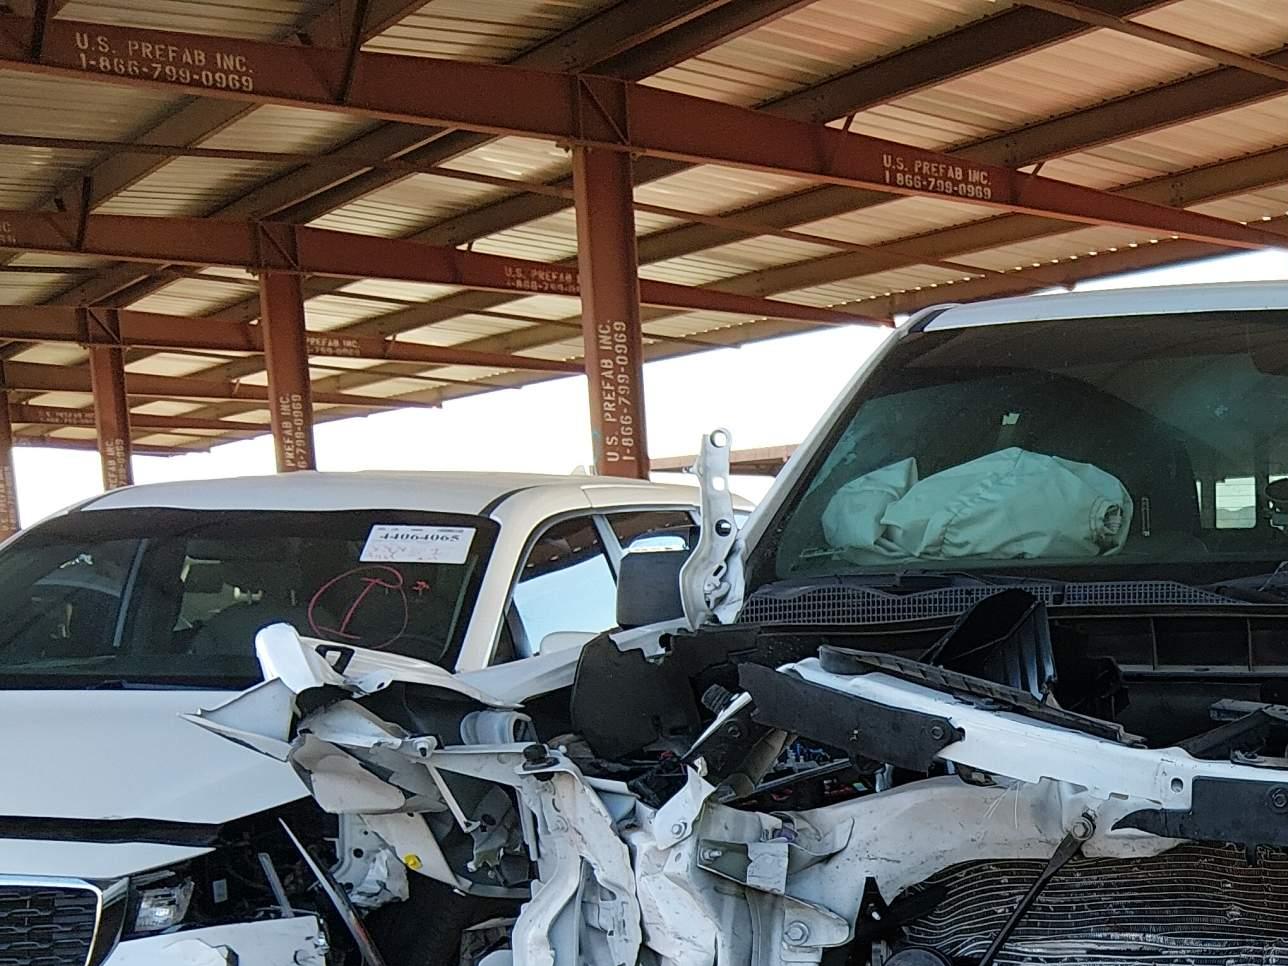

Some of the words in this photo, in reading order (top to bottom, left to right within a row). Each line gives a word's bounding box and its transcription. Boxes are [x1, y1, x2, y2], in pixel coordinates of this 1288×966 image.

[75, 31, 117, 54] U.S.
[128, 40, 206, 66] PREFAB
[215, 52, 253, 74] INC.
[79, 52, 253, 92] 1-866-799-0969
[883, 154, 908, 171] U.S.
[914, 160, 963, 180] PREFAB
[968, 169, 992, 185] INC.
[598, 319, 613, 351] INC.
[600, 358, 618, 422] PREFAB
[613, 321, 635, 461] 1-866-799-0969
[281, 421, 296, 467] PREFAB
